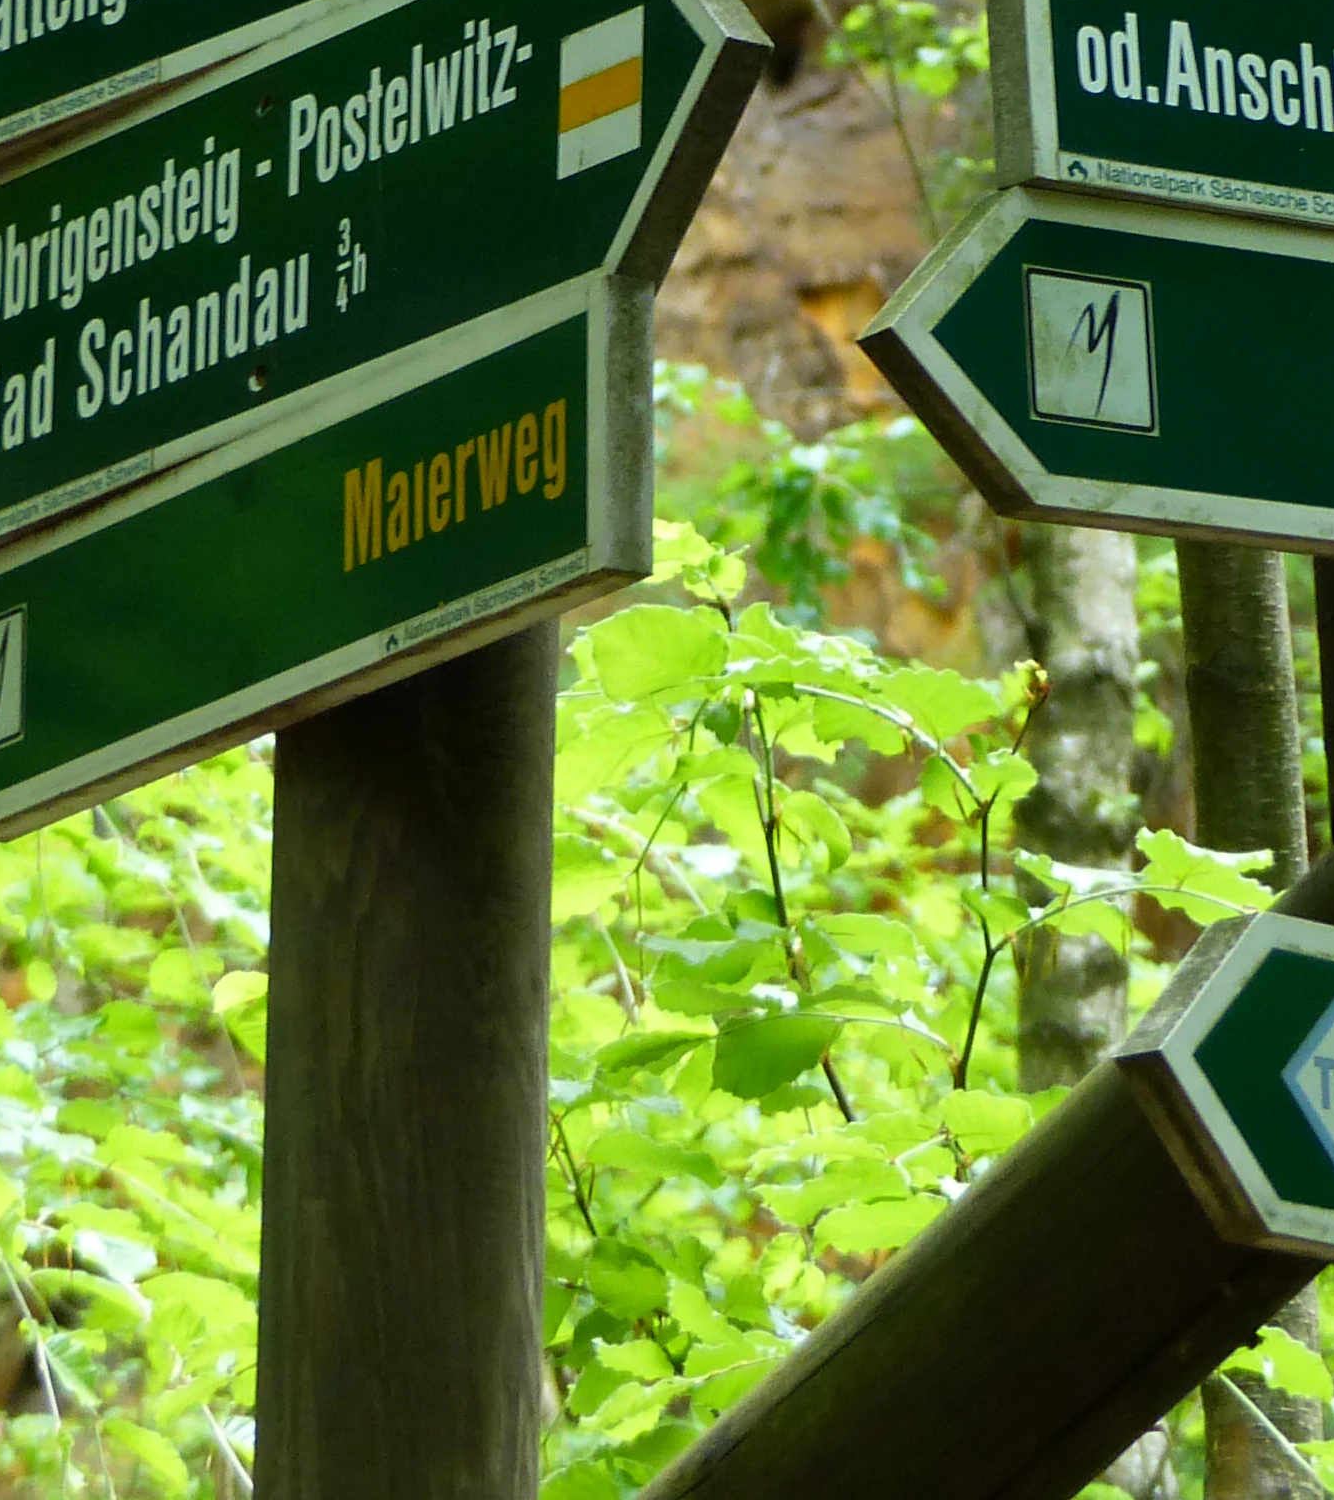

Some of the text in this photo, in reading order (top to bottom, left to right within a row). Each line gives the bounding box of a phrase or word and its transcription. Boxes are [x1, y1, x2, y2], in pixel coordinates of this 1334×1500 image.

[287, 17, 533, 198] Postelwitz-
[1096, 161, 1208, 199] Nationalpark
[1210, 179, 1309, 212] Sächsische
[76, 252, 310, 420] Schandau
